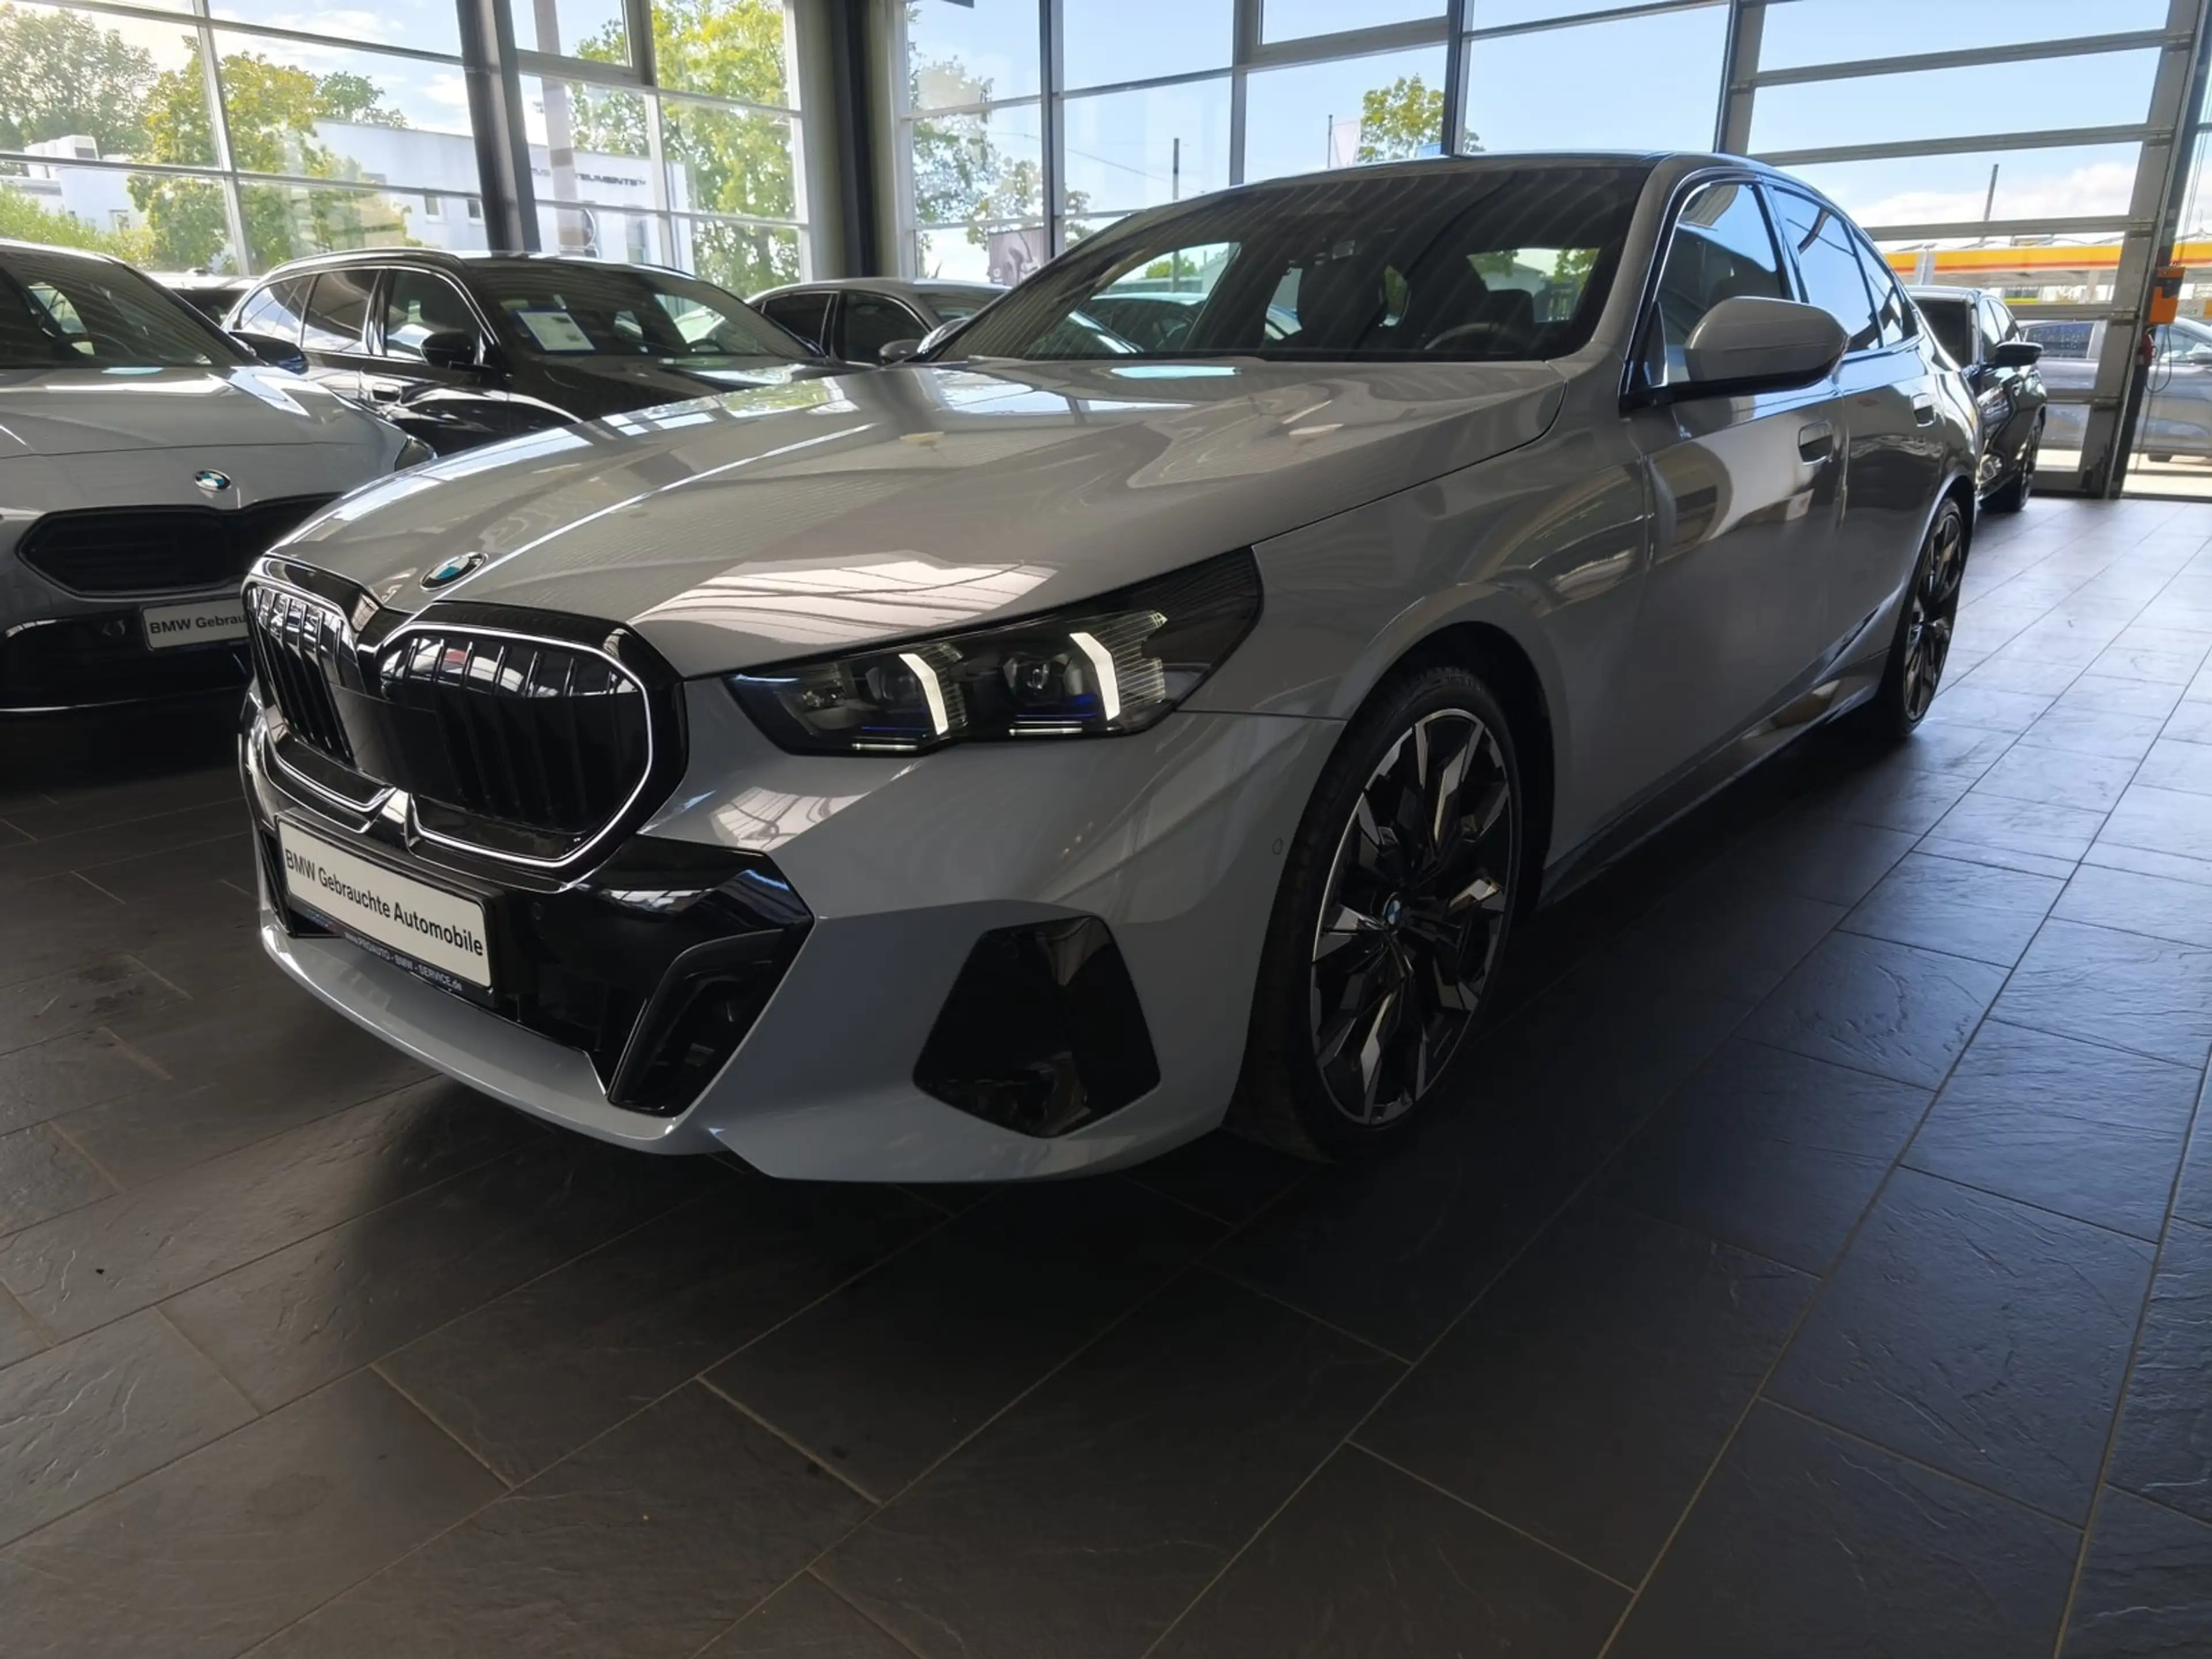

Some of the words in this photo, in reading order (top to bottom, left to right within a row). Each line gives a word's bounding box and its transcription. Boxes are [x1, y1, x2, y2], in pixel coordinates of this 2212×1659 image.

[149, 618, 191, 634] BMW
[285, 848, 315, 881] BMW
[319, 866, 391, 918] Gebrauchte
[394, 901, 483, 956] Automobile
